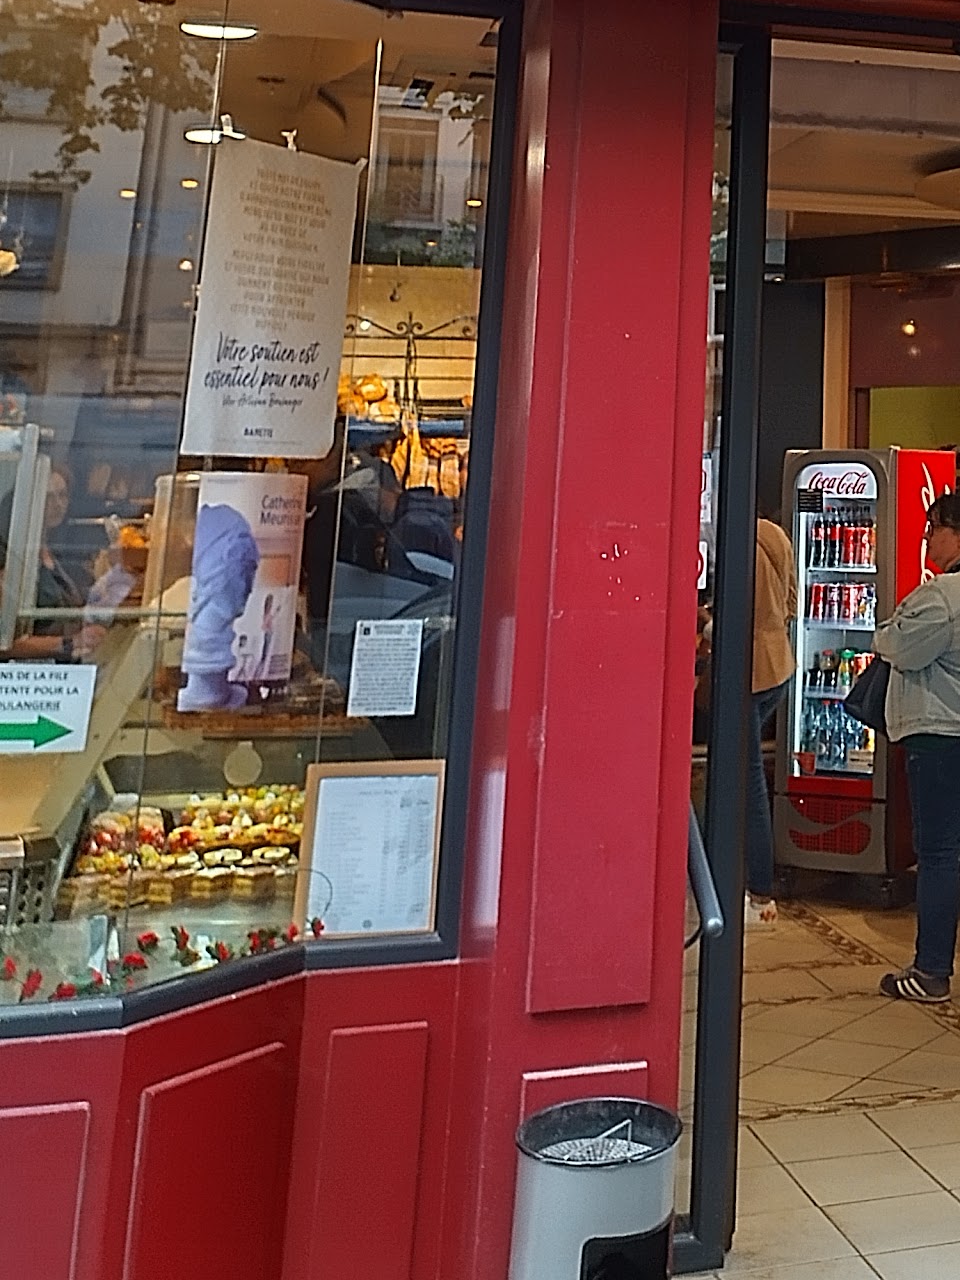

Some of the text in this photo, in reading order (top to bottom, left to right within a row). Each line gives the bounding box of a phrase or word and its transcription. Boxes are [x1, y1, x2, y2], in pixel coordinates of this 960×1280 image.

[216, 331, 321, 365] Votre soutien est
[204, 365, 260, 390] essentiel
[258, 370, 287, 395] pour
[289, 371, 321, 391] nous
[33, 671, 46, 680] LA
[66, 687, 79, 695] LA
